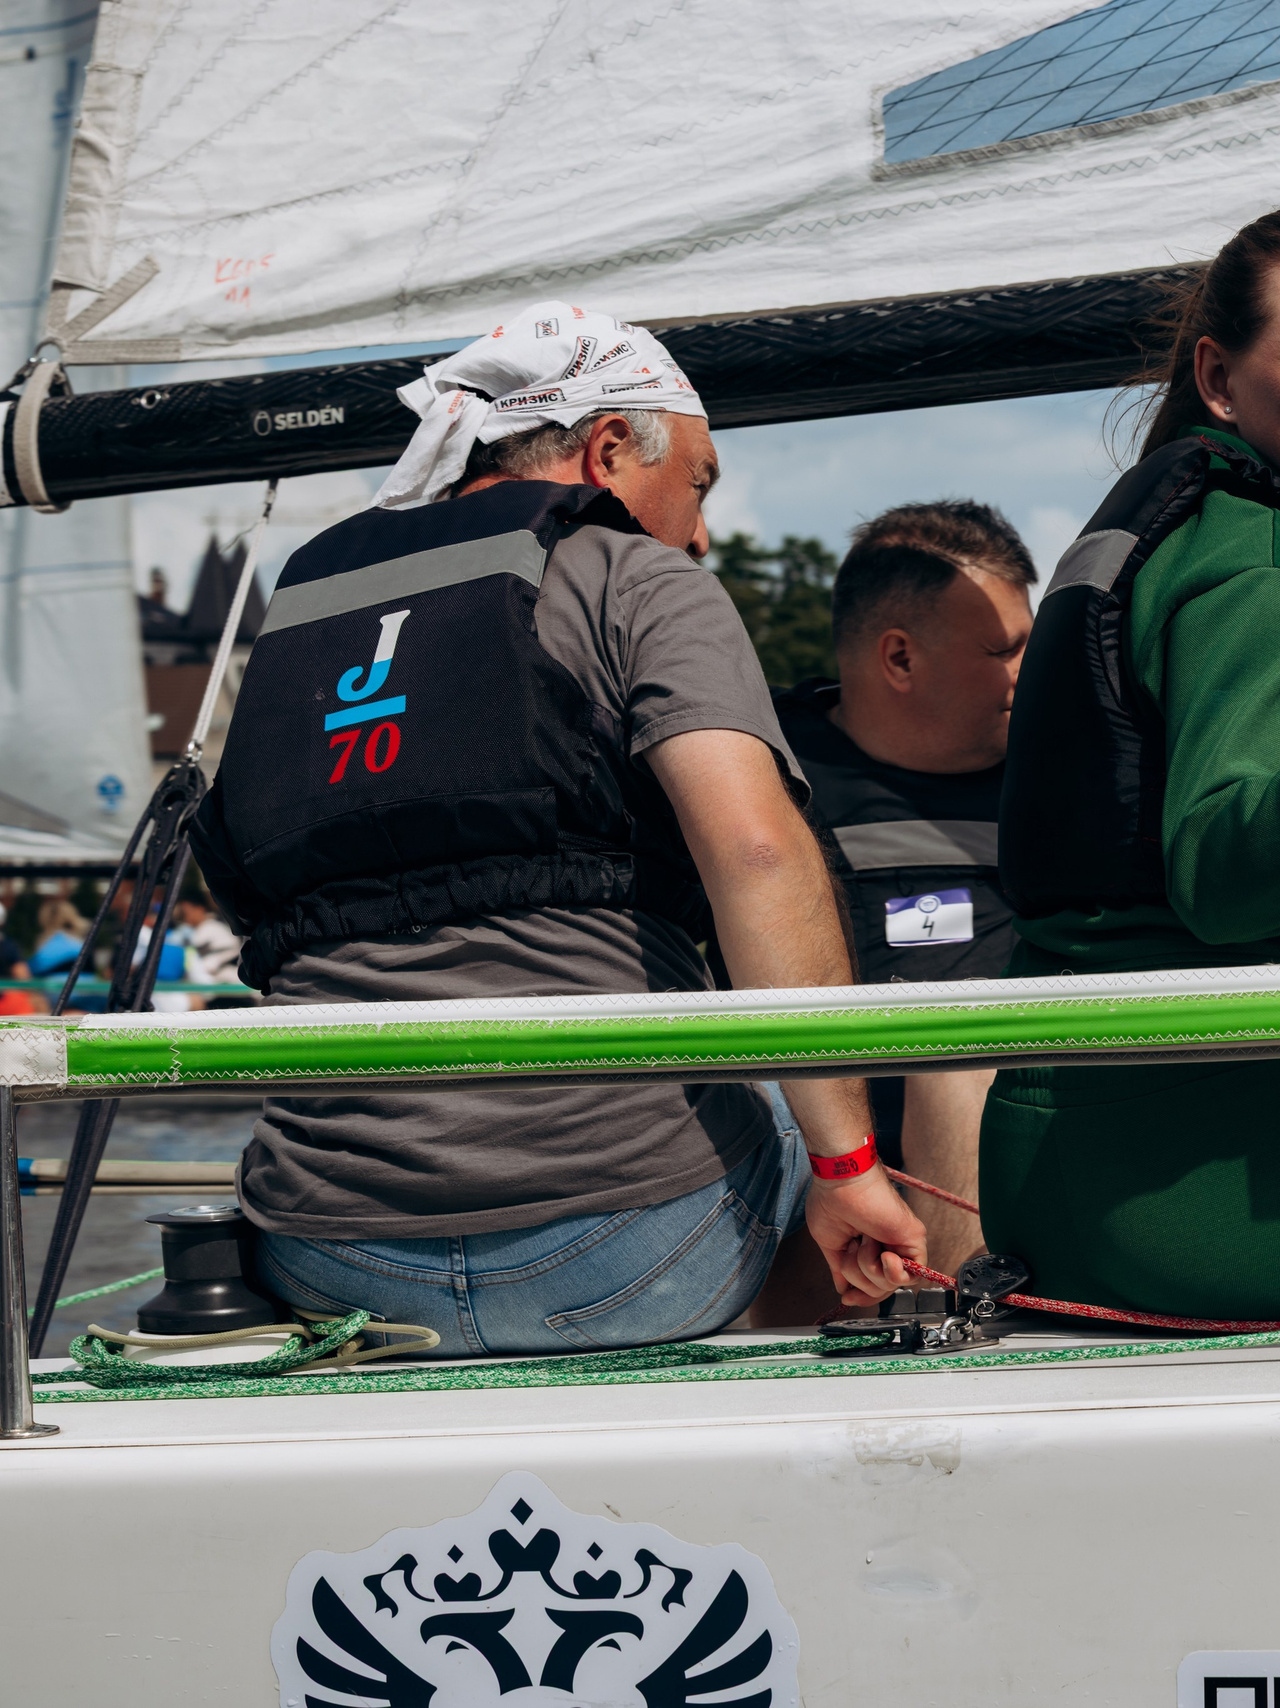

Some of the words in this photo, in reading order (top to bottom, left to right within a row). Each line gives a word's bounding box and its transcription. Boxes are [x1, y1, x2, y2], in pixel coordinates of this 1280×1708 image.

[590, 343, 629, 371] РИЗИС
[500, 393, 559, 409] КРИЗИС
[274, 404, 345, 431] SELDÉN
[336, 609, 411, 702] J
[328, 721, 401, 785] 70
[922, 915, 935, 938] 4
